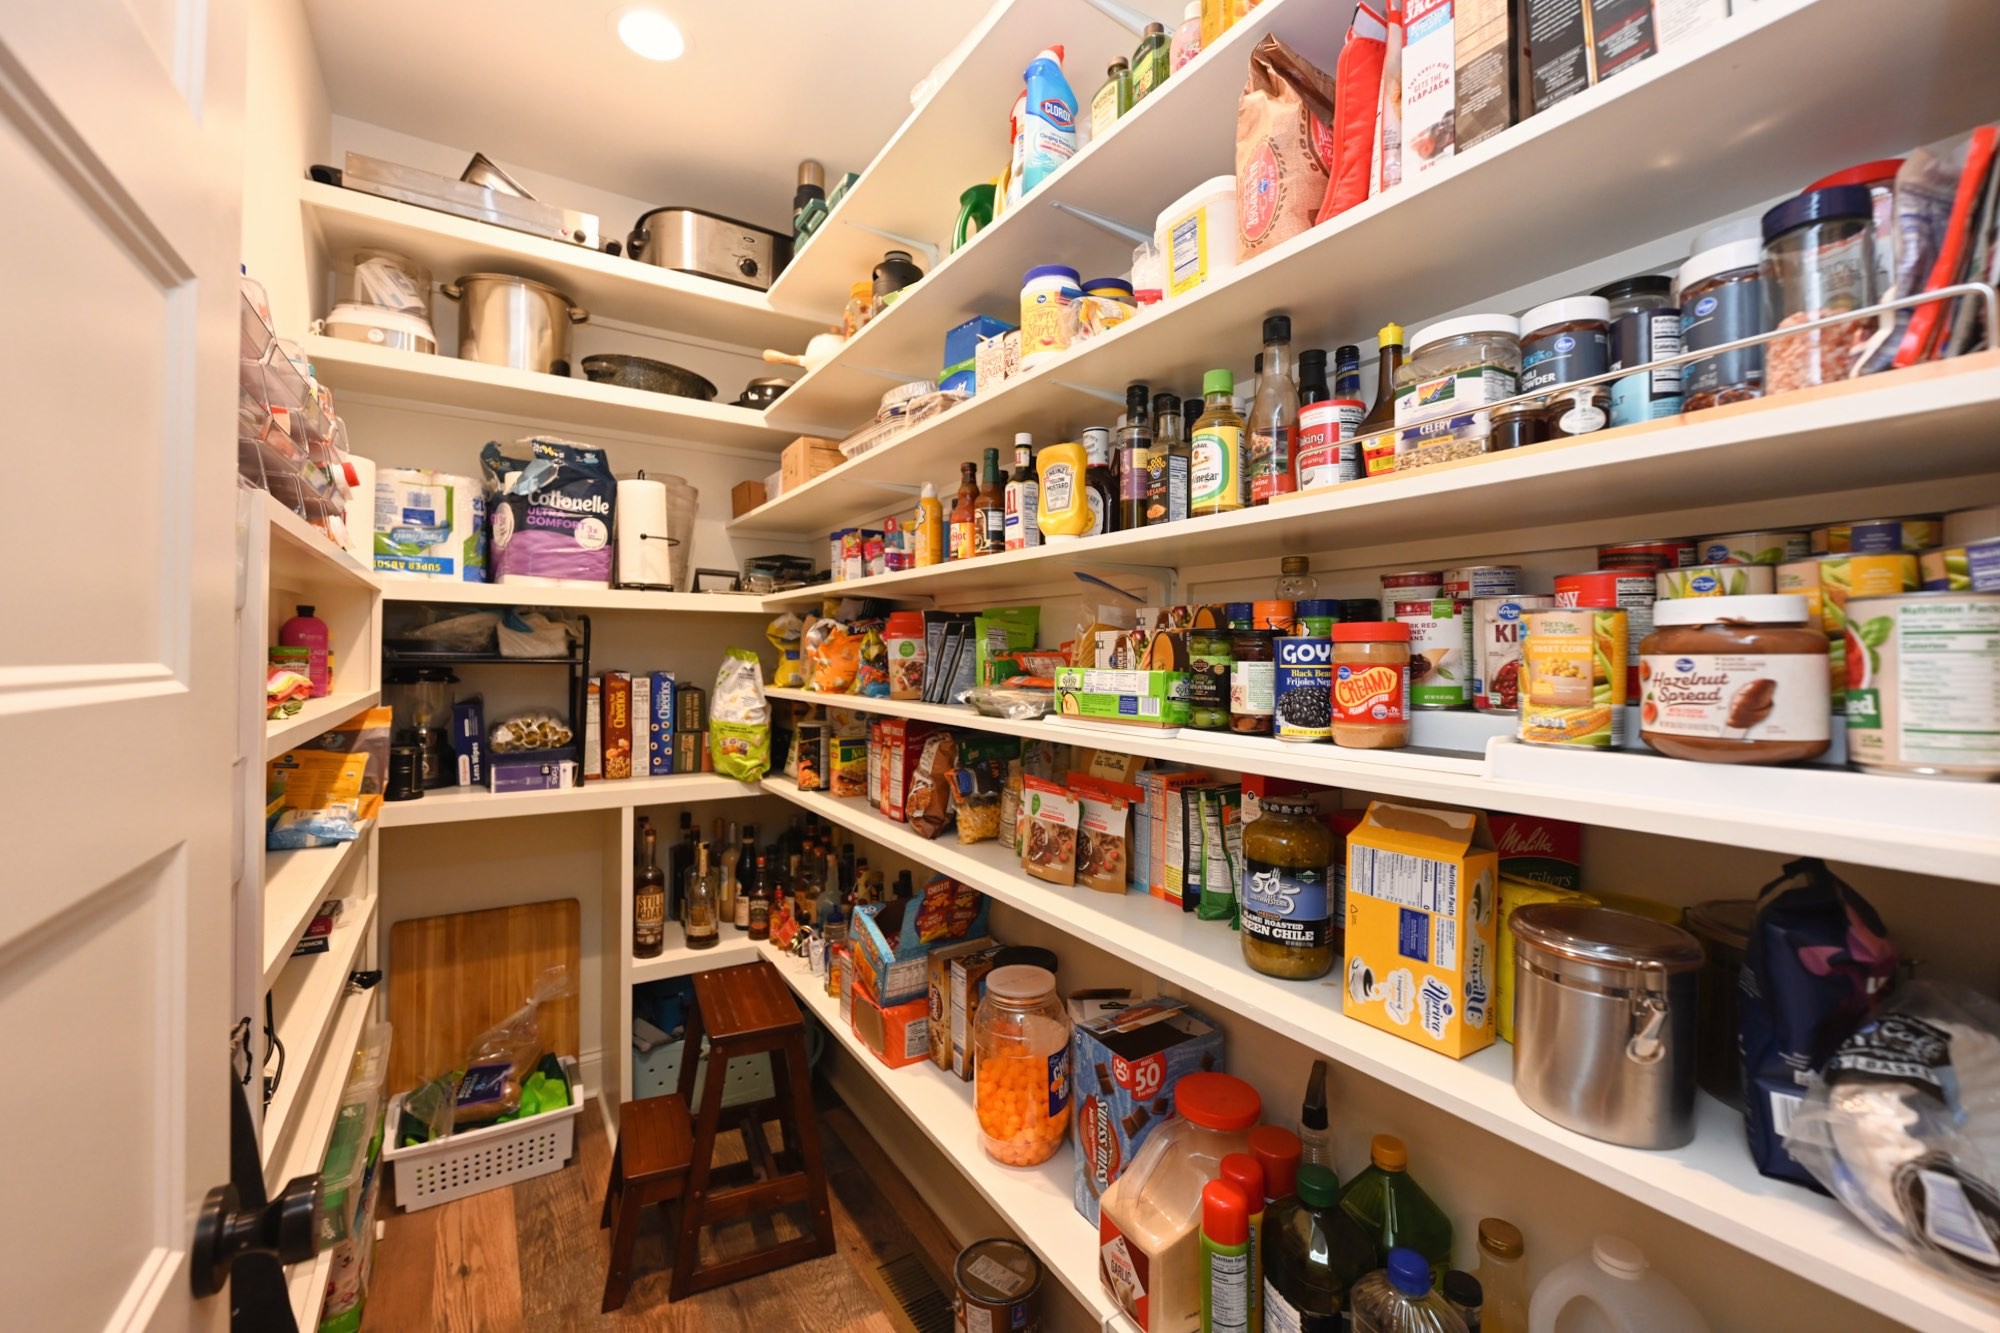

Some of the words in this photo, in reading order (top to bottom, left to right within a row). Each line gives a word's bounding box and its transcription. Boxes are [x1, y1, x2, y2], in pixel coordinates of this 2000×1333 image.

[1408, 78, 1451, 106] FLAPJACK
[1045, 102, 1071, 122] CLOROX
[1420, 419, 1452, 436] CELERY
[1193, 472, 1220, 485] inegar
[528, 490, 610, 515] Cottonelle
[526, 515, 587, 530] COMFORT
[408, 561, 441, 572] SUPER
[1282, 643, 1331, 664] GOY
[1563, 645, 1590, 653] CORN
[1286, 677, 1316, 686] Frijoles
[1316, 677, 1331, 687] Neg
[1291, 669, 1313, 677] Black
[1653, 671, 1731, 691] Hazelnut
[1339, 670, 1394, 704] CREAMY
[1658, 687, 1723, 704] Spread
[613, 690, 626, 729] Cheerios
[658, 680, 671, 720] Cheerios
[471, 741, 481, 764] Wipes
[472, 764, 481, 781] Lens
[1497, 822, 1553, 854] Melitta
[1423, 859, 1431, 883] Calories
[1448, 864, 1457, 896] Nutrition
[638, 893, 663, 907] STILL
[1447, 896, 1456, 917] Facts
[1264, 919, 1304, 931] ROASTED
[1272, 928, 1315, 941] CHILE
[1135, 1062, 1161, 1092] 50
[1095, 1095, 1109, 1147] SWISS
[1095, 1145, 1109, 1188] MISS
[1110, 1259, 1132, 1285] GARLIC
